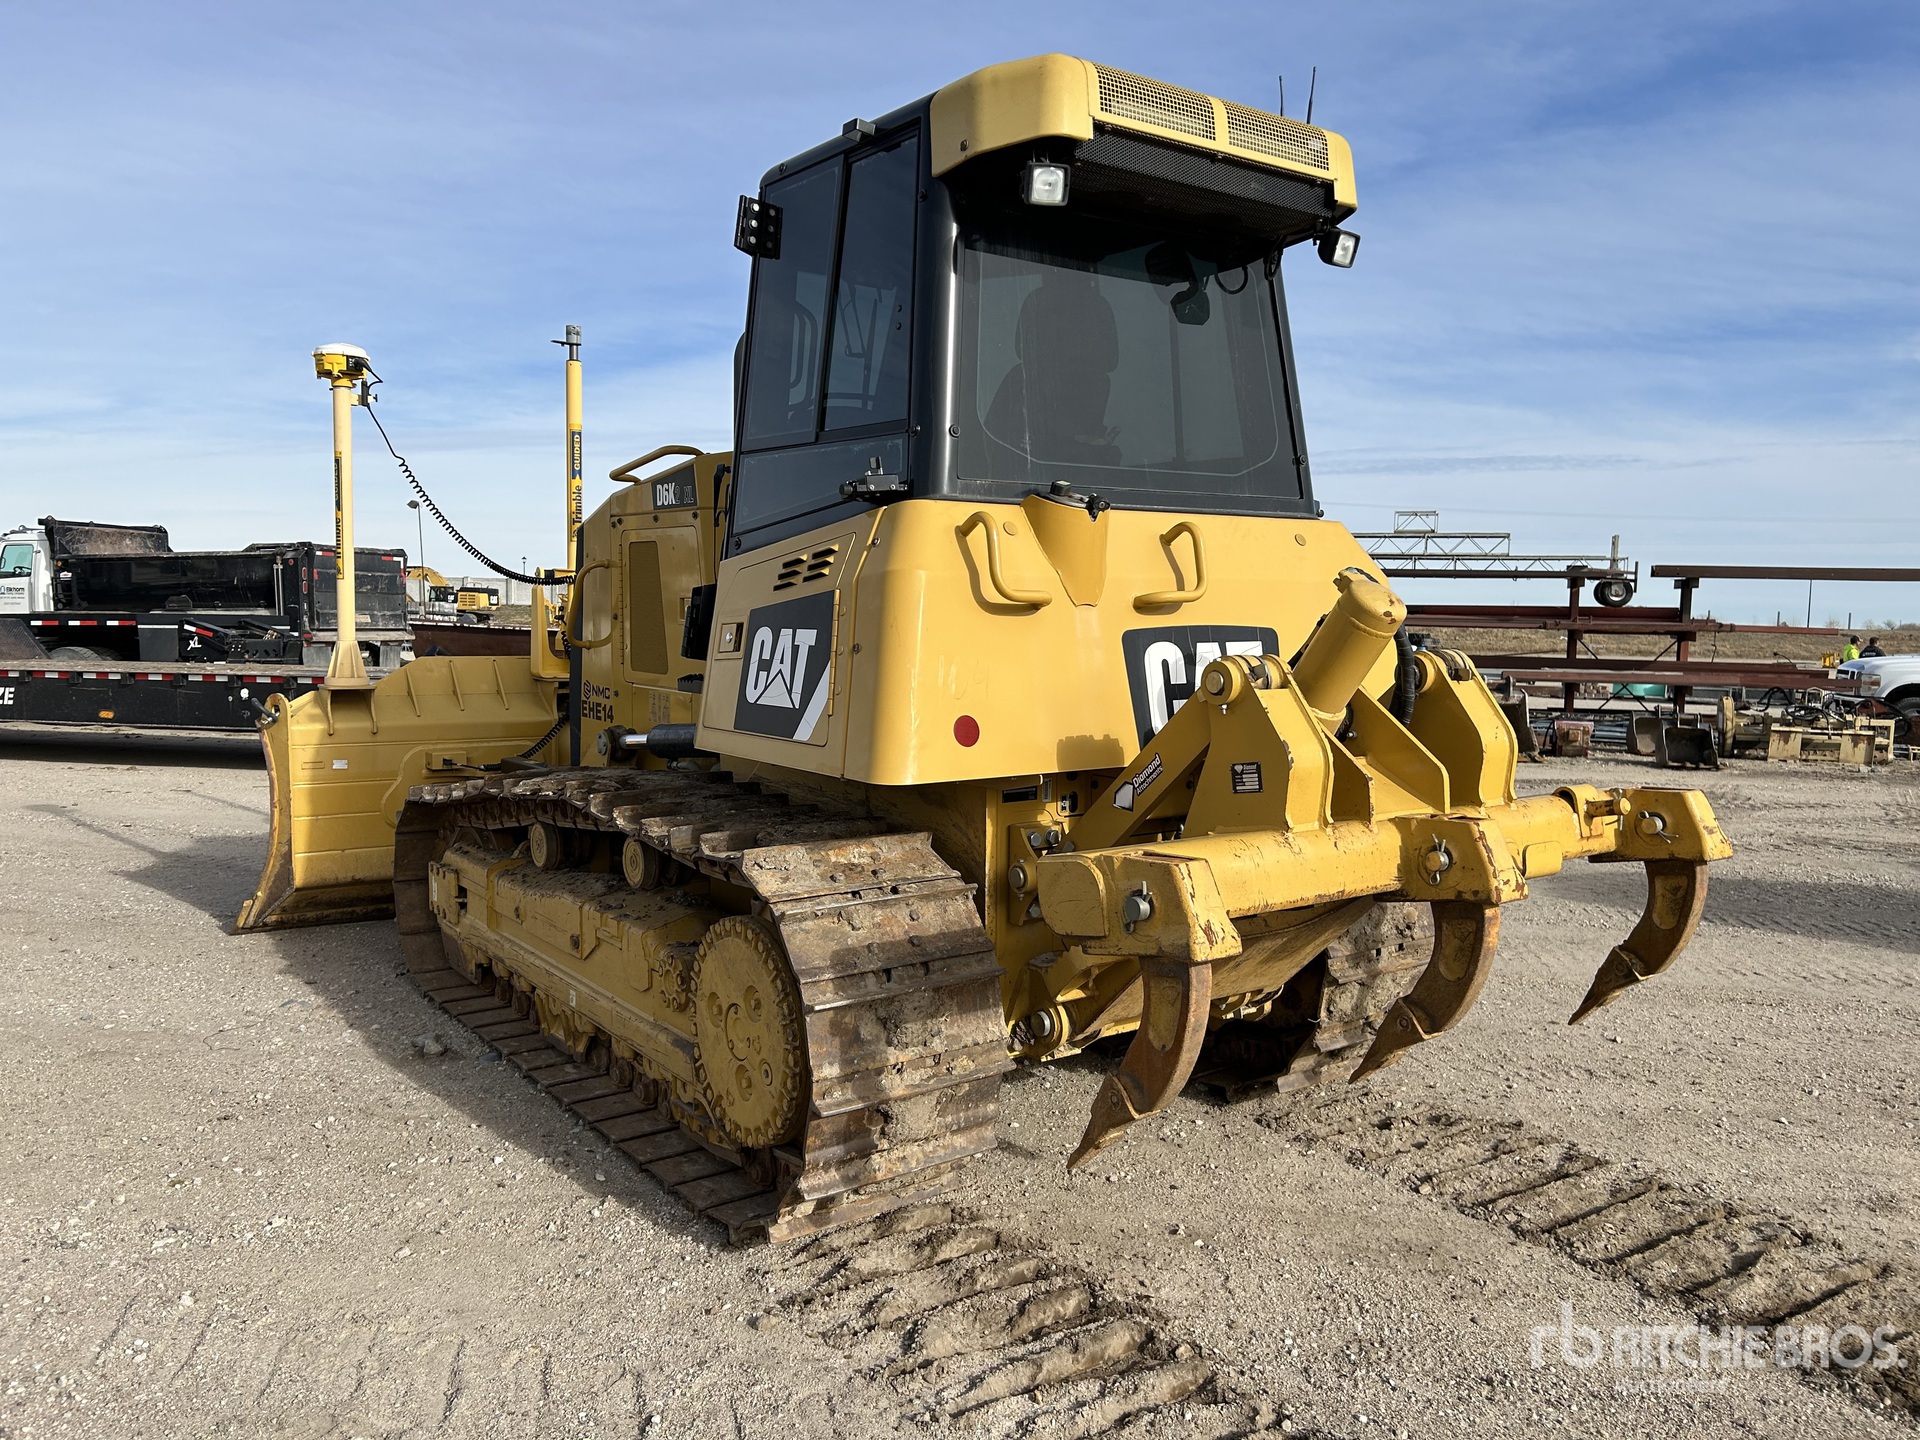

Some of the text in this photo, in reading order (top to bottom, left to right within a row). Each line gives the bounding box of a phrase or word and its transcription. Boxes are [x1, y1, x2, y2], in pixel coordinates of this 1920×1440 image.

[572, 434, 582, 525] Trimble GUIDED
[746, 626, 817, 709] CAT
[592, 685, 610, 699] NMC
[1144, 641, 1263, 735] CA
[582, 700, 614, 723] EHE14
[1132, 753, 1161, 788] Diamond
[1136, 766, 1163, 795] Attachments
